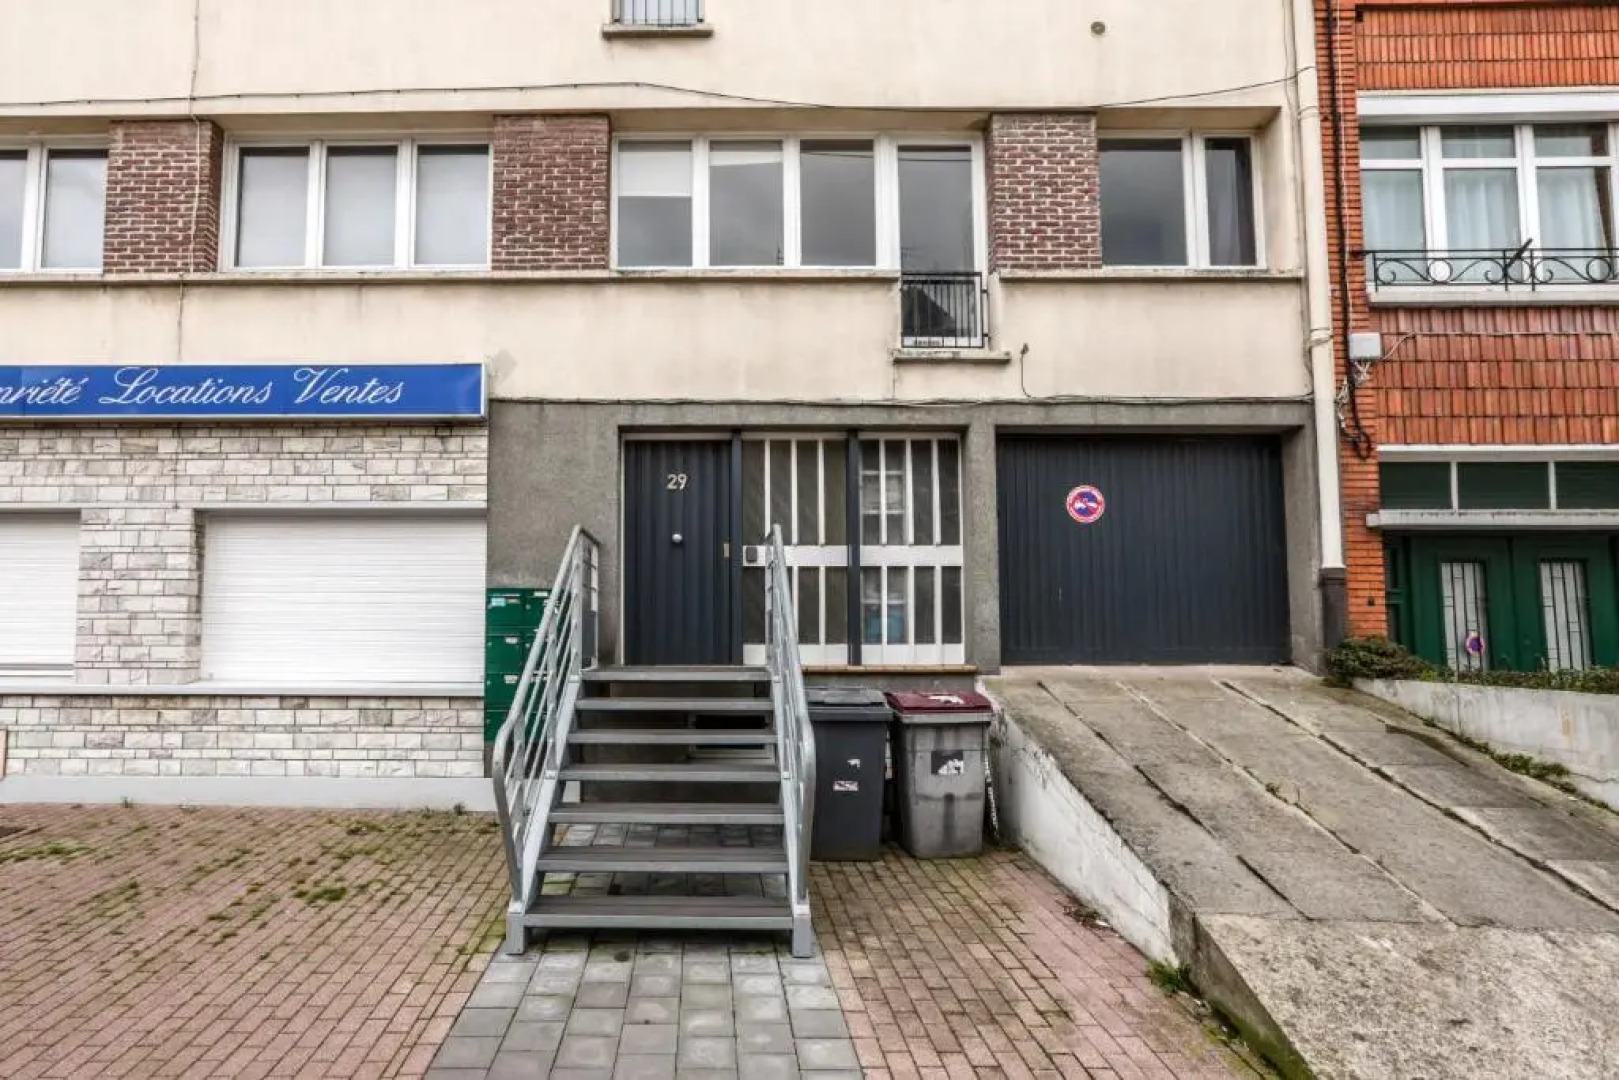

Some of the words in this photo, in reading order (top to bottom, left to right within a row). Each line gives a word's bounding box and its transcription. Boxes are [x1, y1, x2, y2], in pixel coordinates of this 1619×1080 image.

[98, 366, 273, 404] Locations
[293, 367, 404, 404] Ventes
[667, 473, 687, 490] 29
